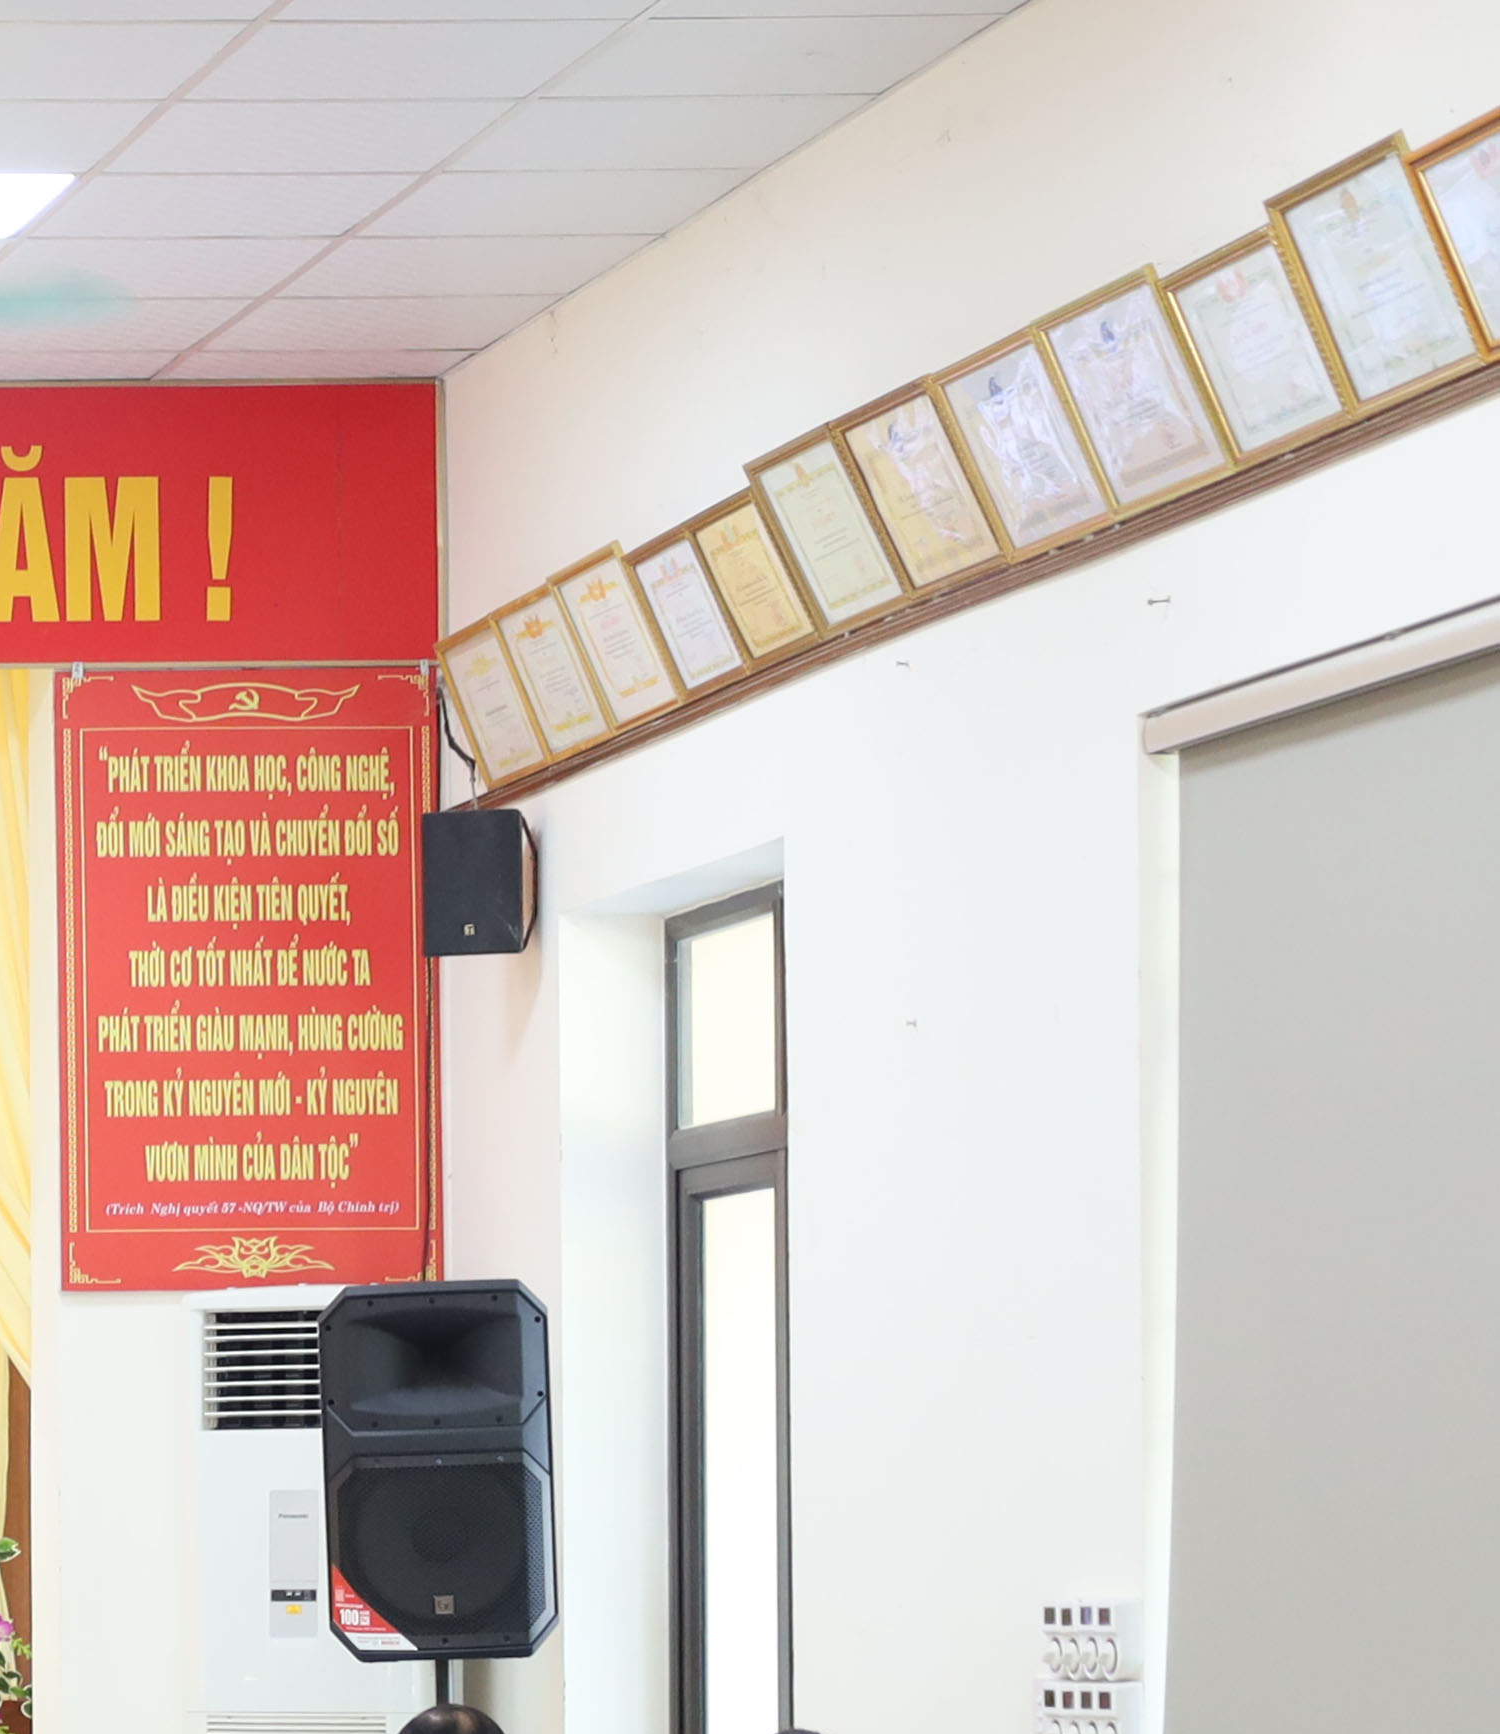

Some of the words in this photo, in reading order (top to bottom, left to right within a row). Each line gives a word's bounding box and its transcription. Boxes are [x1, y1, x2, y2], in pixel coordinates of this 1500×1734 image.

[205, 475, 234, 622] !
[98, 746, 150, 793] “PHÁT
[153, 740, 202, 793] TRIỂN
[206, 755, 250, 792] KHOA
[254, 754, 292, 800] HỌC,
[296, 747, 342, 792] CÔNG
[345, 747, 395, 800] NGHỆ,
[96, 806, 124, 858] ĐỔI
[128, 813, 161, 858] MỚI
[165, 812, 211, 857] SÁNG
[214, 819, 246, 865] TẠO
[249, 812, 272, 857] VÀ
[275, 804, 340, 857] CHUYỂN
[344, 804, 372, 857] ĐỔI
[376, 806, 399, 857] SỐ
[147, 877, 168, 922] LÀ
[171, 873, 209, 922] ĐIỀU
[213, 877, 252, 930] KIỆN
[255, 876, 293, 921] TIÊN
[297, 872, 351, 926] QUYẾT,
[128, 941, 166, 988] THỜI
[170, 946, 193, 987] CƠ
[196, 936, 226, 987] TỐT
[229, 935, 273, 987] NHẤT
[276, 934, 299, 987] ĐỂ
[302, 941, 348, 987] NƯỚC
[351, 949, 371, 986] TA
[98, 1007, 140, 1052] PHÁT
[143, 999, 192, 1052] TRIỂN
[196, 1007, 235, 1052] GIÀU
[239, 1014, 294, 1060] MẠNH,
[297, 1006, 343, 1051] HÙNG
[347, 1005, 404, 1051] CƯỜNG
[104, 1079, 159, 1118] TRONG
[163, 1067, 184, 1117] KỶ
[188, 1071, 255, 1117] NGUYÊN
[258, 1071, 291, 1116] MỚI
[306, 1066, 328, 1116] KỶ
[332, 1070, 399, 1116] NGUYÊN
[145, 1141, 190, 1182] VƯƠN
[194, 1136, 238, 1181] MÌNH
[242, 1131, 276, 1181] CỦA
[280, 1135, 314, 1180] DÂN
[317, 1133, 359, 1189] TỘC”
